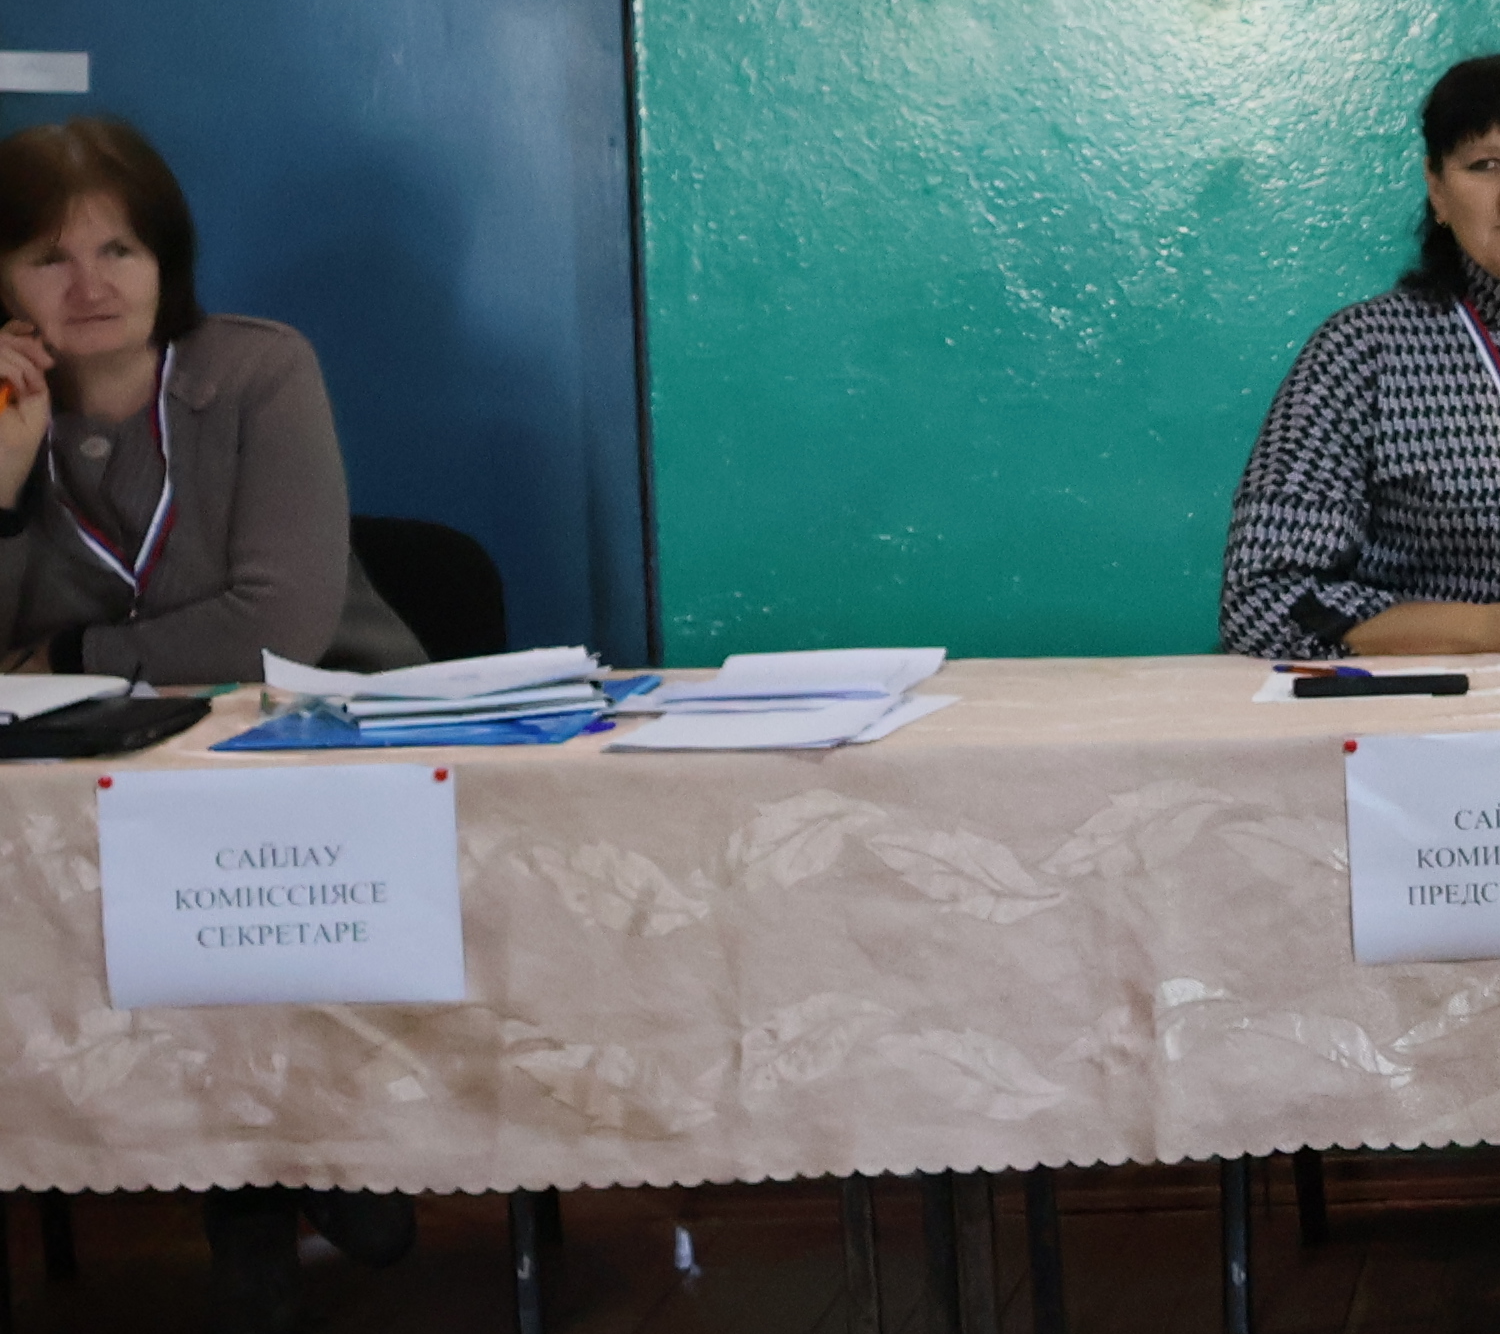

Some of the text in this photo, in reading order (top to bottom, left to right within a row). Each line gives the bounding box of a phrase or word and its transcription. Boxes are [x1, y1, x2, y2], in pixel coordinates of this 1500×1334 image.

[215, 842, 342, 870] САЙЛАУ
[174, 881, 387, 911] КОМИССИЯСЕ
[196, 921, 371, 949] СЕКРЕТАРЕ
